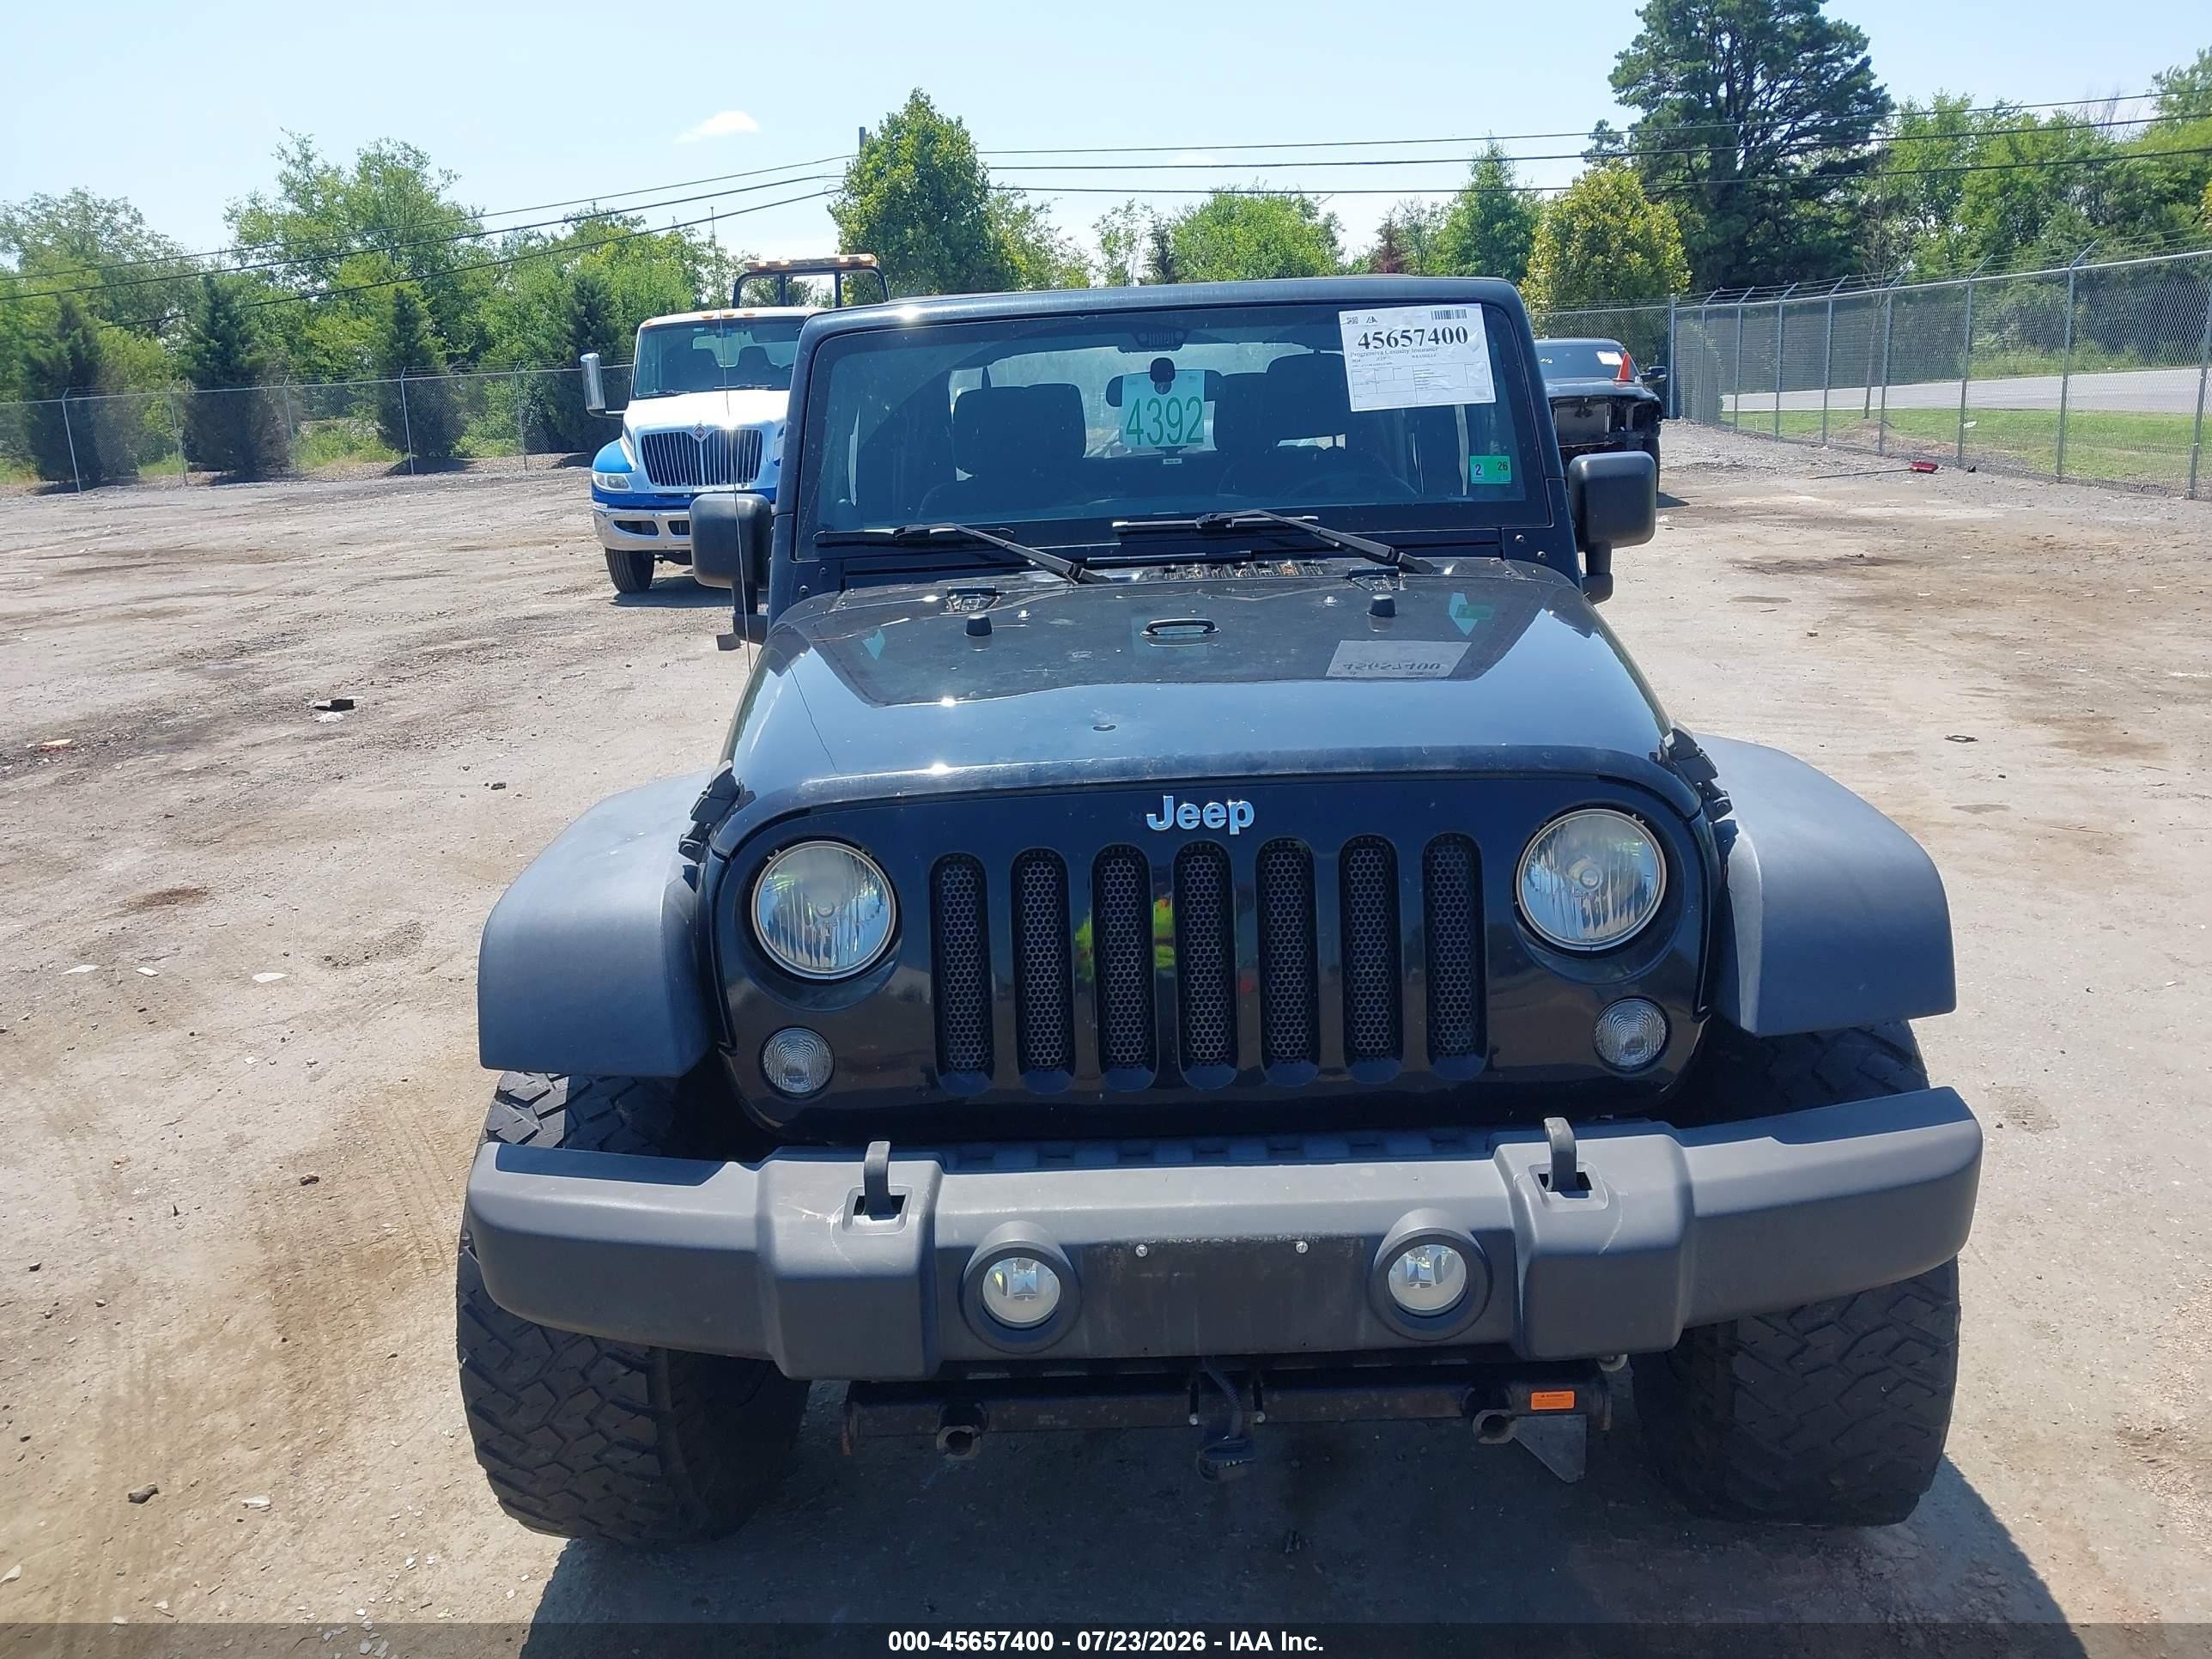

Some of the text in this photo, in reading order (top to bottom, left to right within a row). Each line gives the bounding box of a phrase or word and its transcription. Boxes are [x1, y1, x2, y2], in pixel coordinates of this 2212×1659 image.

[1358, 325, 1469, 349] 45657400
[1126, 396, 1204, 446] 4392
[1475, 461, 1509, 476] 2 26
[1146, 795, 1255, 836] Jeep
